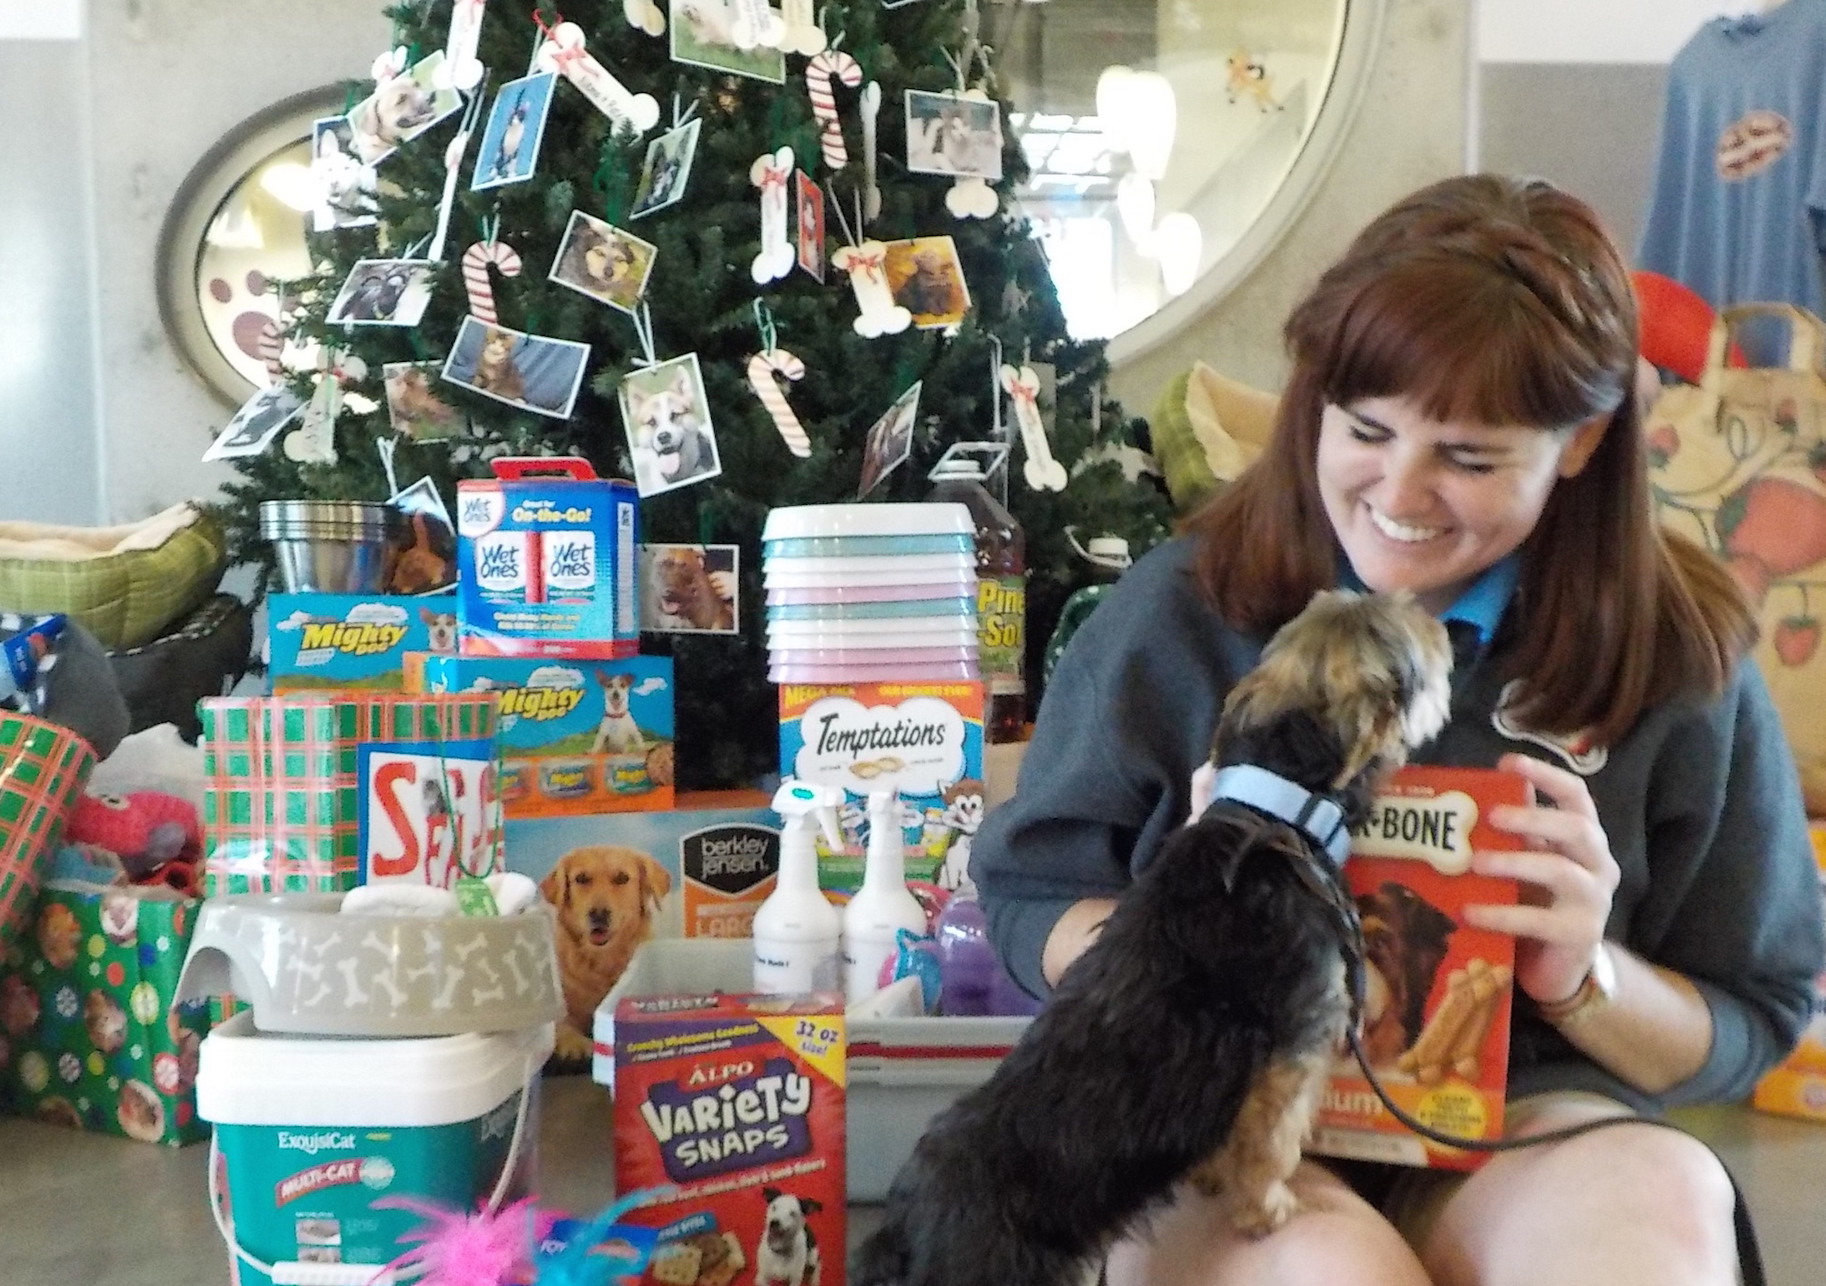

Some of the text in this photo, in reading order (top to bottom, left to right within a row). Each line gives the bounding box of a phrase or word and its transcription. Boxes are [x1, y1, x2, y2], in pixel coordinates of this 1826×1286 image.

[482, 541, 519, 564] Wet
[554, 542, 592, 564] Wet
[480, 561, 519, 579] Ones
[550, 560, 591, 577] Ones
[302, 622, 408, 655] Mighty
[977, 615, 1019, 647] -So
[497, 686, 586, 719] Mighty
[816, 713, 946, 759] Temptations
[701, 835, 769, 856] berkley
[796, 1020, 815, 1038] 32
[689, 1061, 755, 1086] ALPO
[676, 1125, 789, 1168] SNAPS
